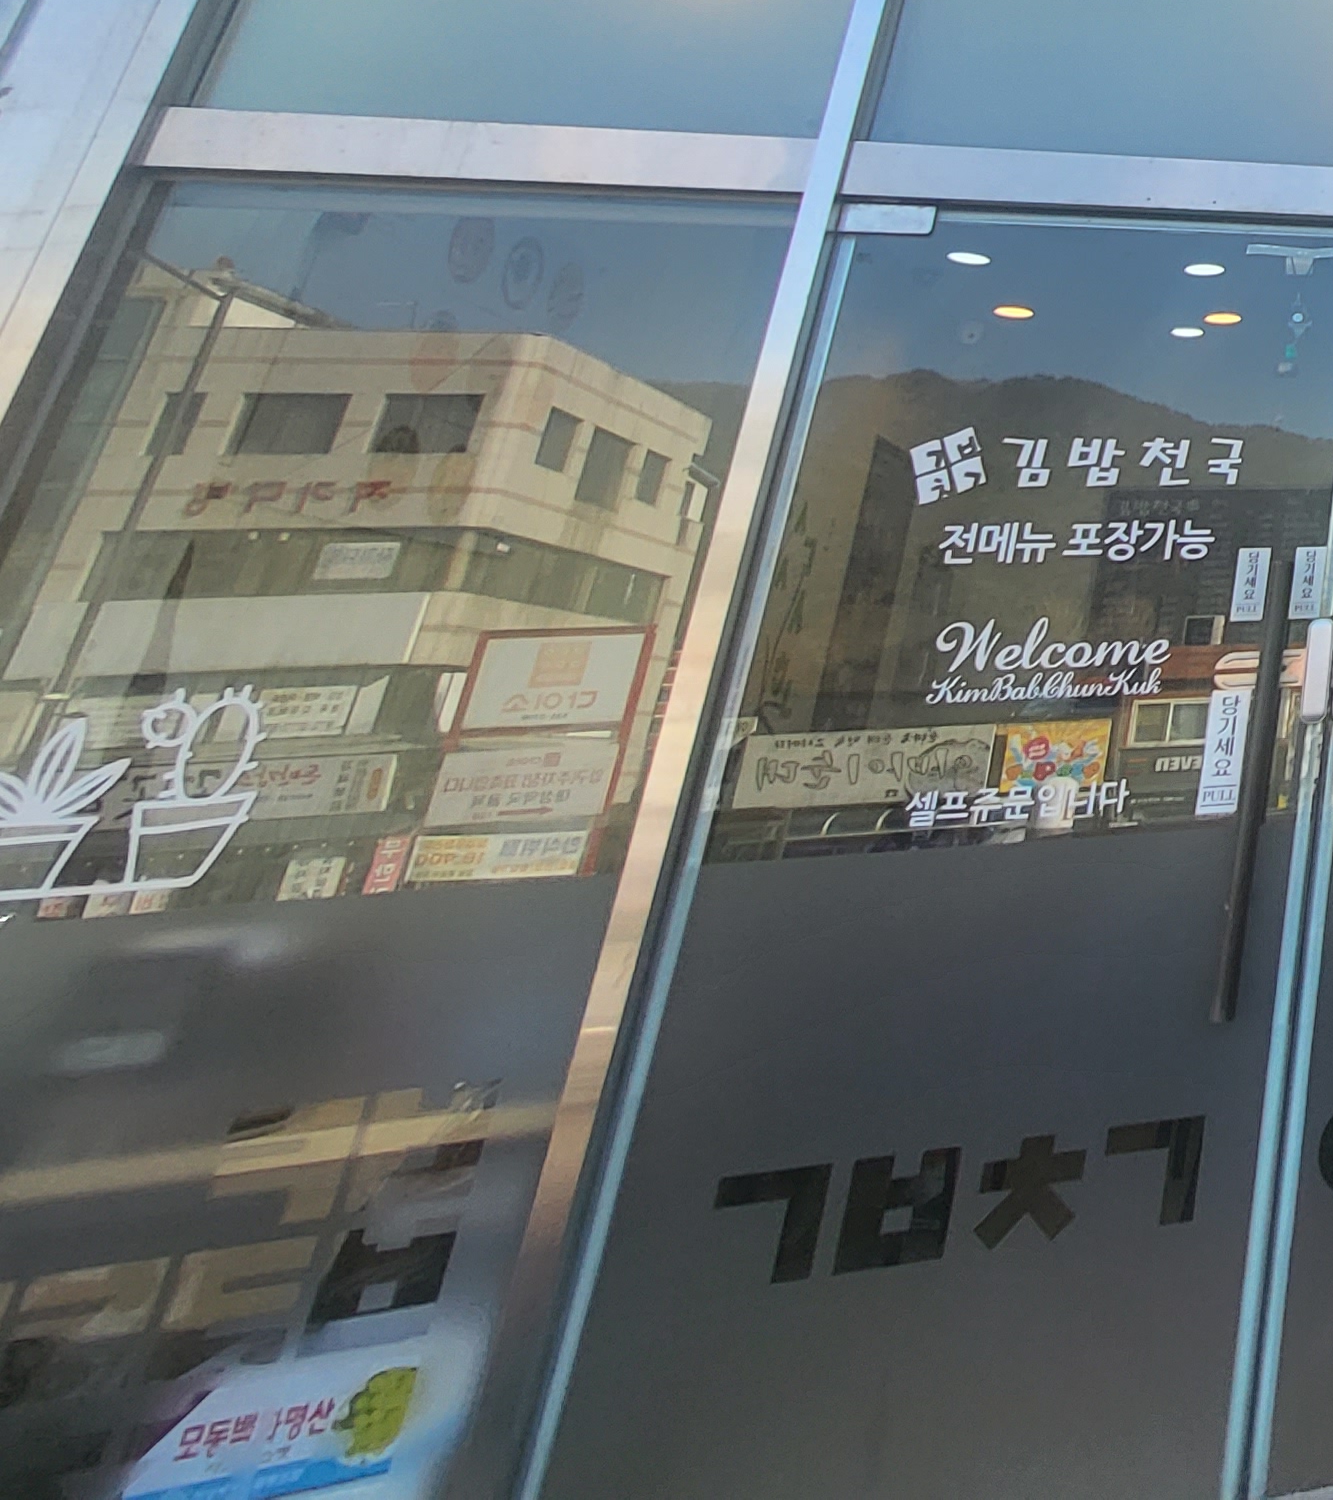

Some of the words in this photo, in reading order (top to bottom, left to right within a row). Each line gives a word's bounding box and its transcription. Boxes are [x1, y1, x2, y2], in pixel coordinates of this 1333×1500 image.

[1003, 437, 1245, 488] 김밥천국
[939, 523, 1056, 565] 전메뉴
[1062, 520, 1216, 562] 포장가능
[1243, 551, 1260, 600] 당기세요
[1301, 550, 1317, 599] 당기세요
[936, 617, 1171, 673] Welcome
[1213, 695, 1241, 778] 당기세요
[905, 779, 1130, 828] 셀프주문입니다
[1204, 788, 1237, 801] PULL
